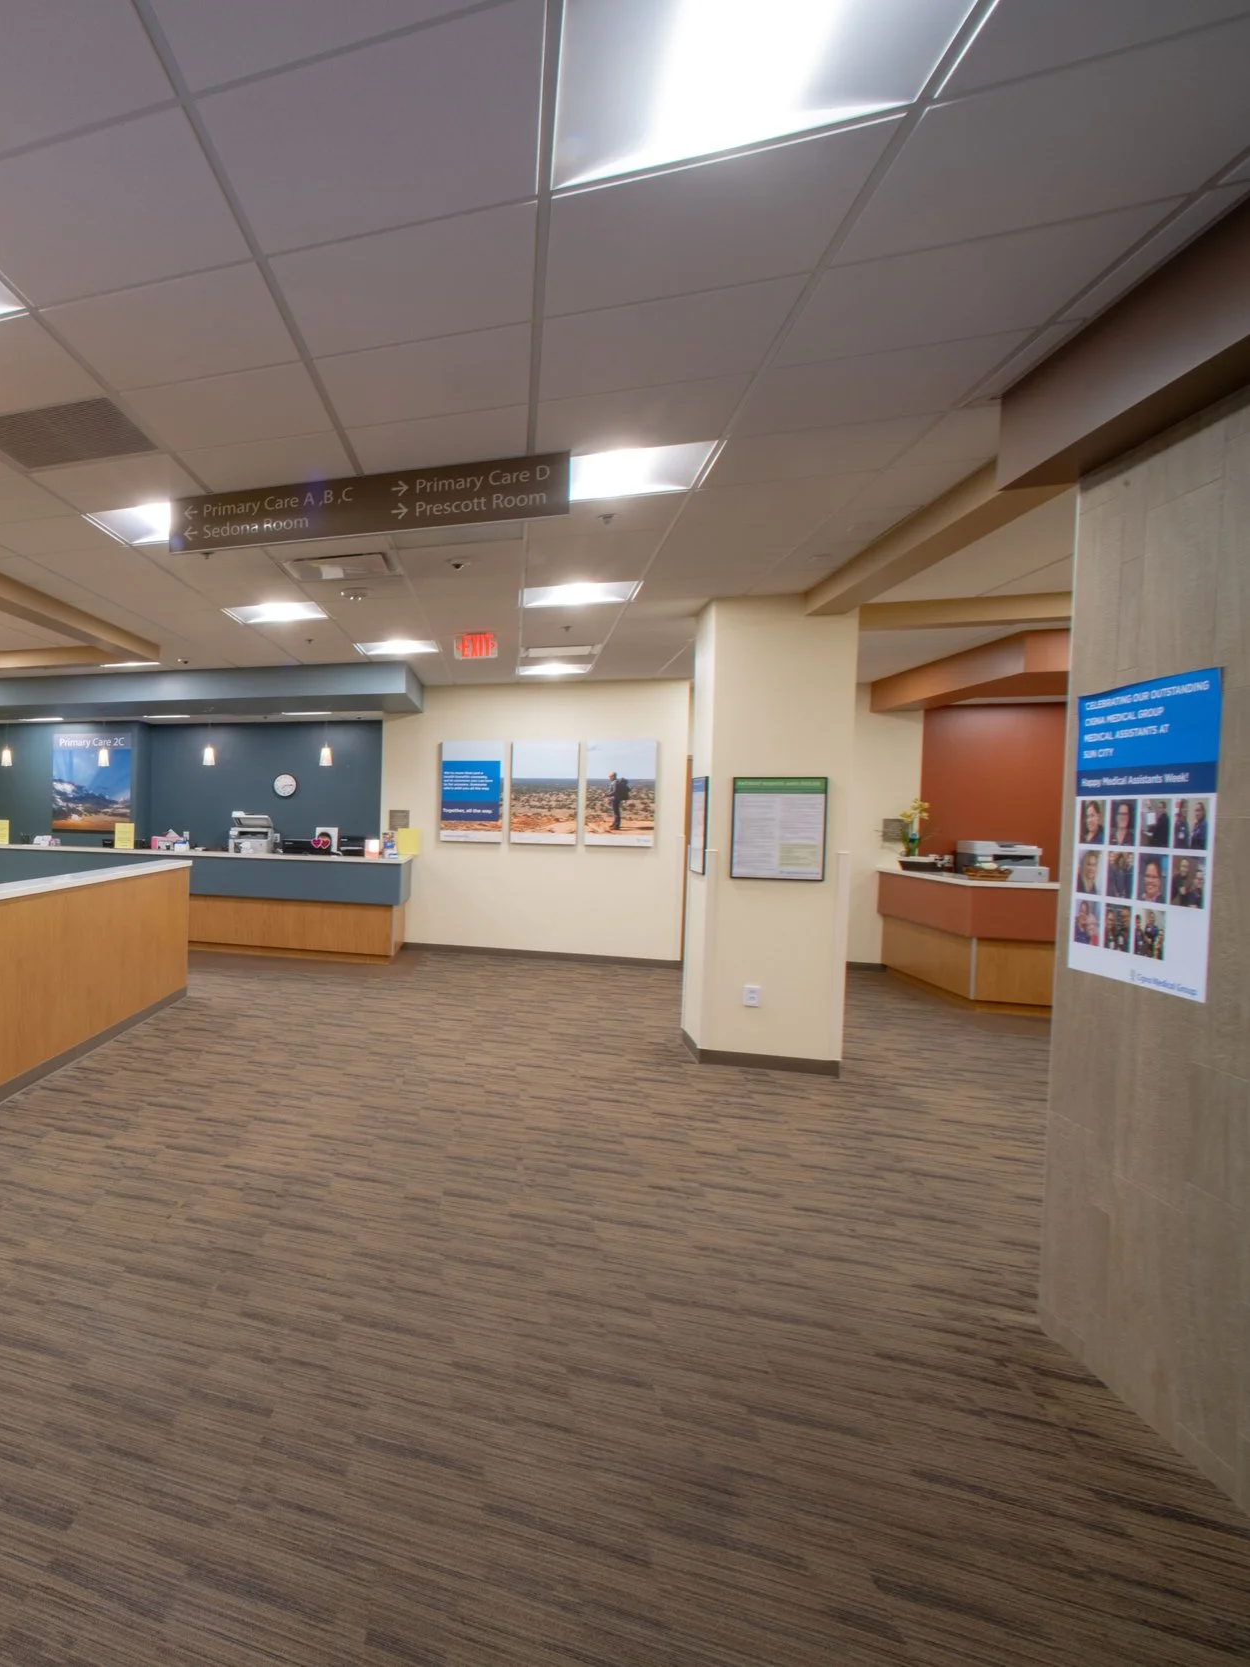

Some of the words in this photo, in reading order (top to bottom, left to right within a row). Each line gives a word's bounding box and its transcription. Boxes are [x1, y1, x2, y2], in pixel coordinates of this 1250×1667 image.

[416, 474, 483, 495] Primary
[489, 470, 530, 486] Care
[536, 465, 551, 481] D
[203, 499, 260, 518] Primary
[264, 496, 299, 511] Care
[303, 492, 315, 506] A
[415, 498, 487, 518] Prescott
[492, 492, 546, 510] Room
[203, 522, 259, 539] Sedona
[263, 517, 309, 532] Room
[461, 633, 493, 657] EXIT
[1085, 695, 1132, 711] CELEBRATING
[1133, 691, 1151, 702] OUR
[1150, 680, 1210, 700] OUTSTANDING
[1106, 711, 1136, 724] MEDICAL
[1137, 706, 1165, 719] GROUP
[59, 737, 91, 749] Primary
[93, 737, 112, 747] Care
[113, 737, 125, 746] 2C
[1084, 731, 1115, 743] MEDICAL
[1115, 725, 1159, 739] ASSISTANTS
[1159, 723, 1171, 735] AT
[1083, 749, 1097, 759] SUN
[1097, 747, 1115, 758] CITY
[1080, 777, 1102, 788] Happy
[1102, 775, 1128, 786] Medical
[1128, 774, 1163, 785] Assistants
[1163, 772, 1190, 784] Week!
